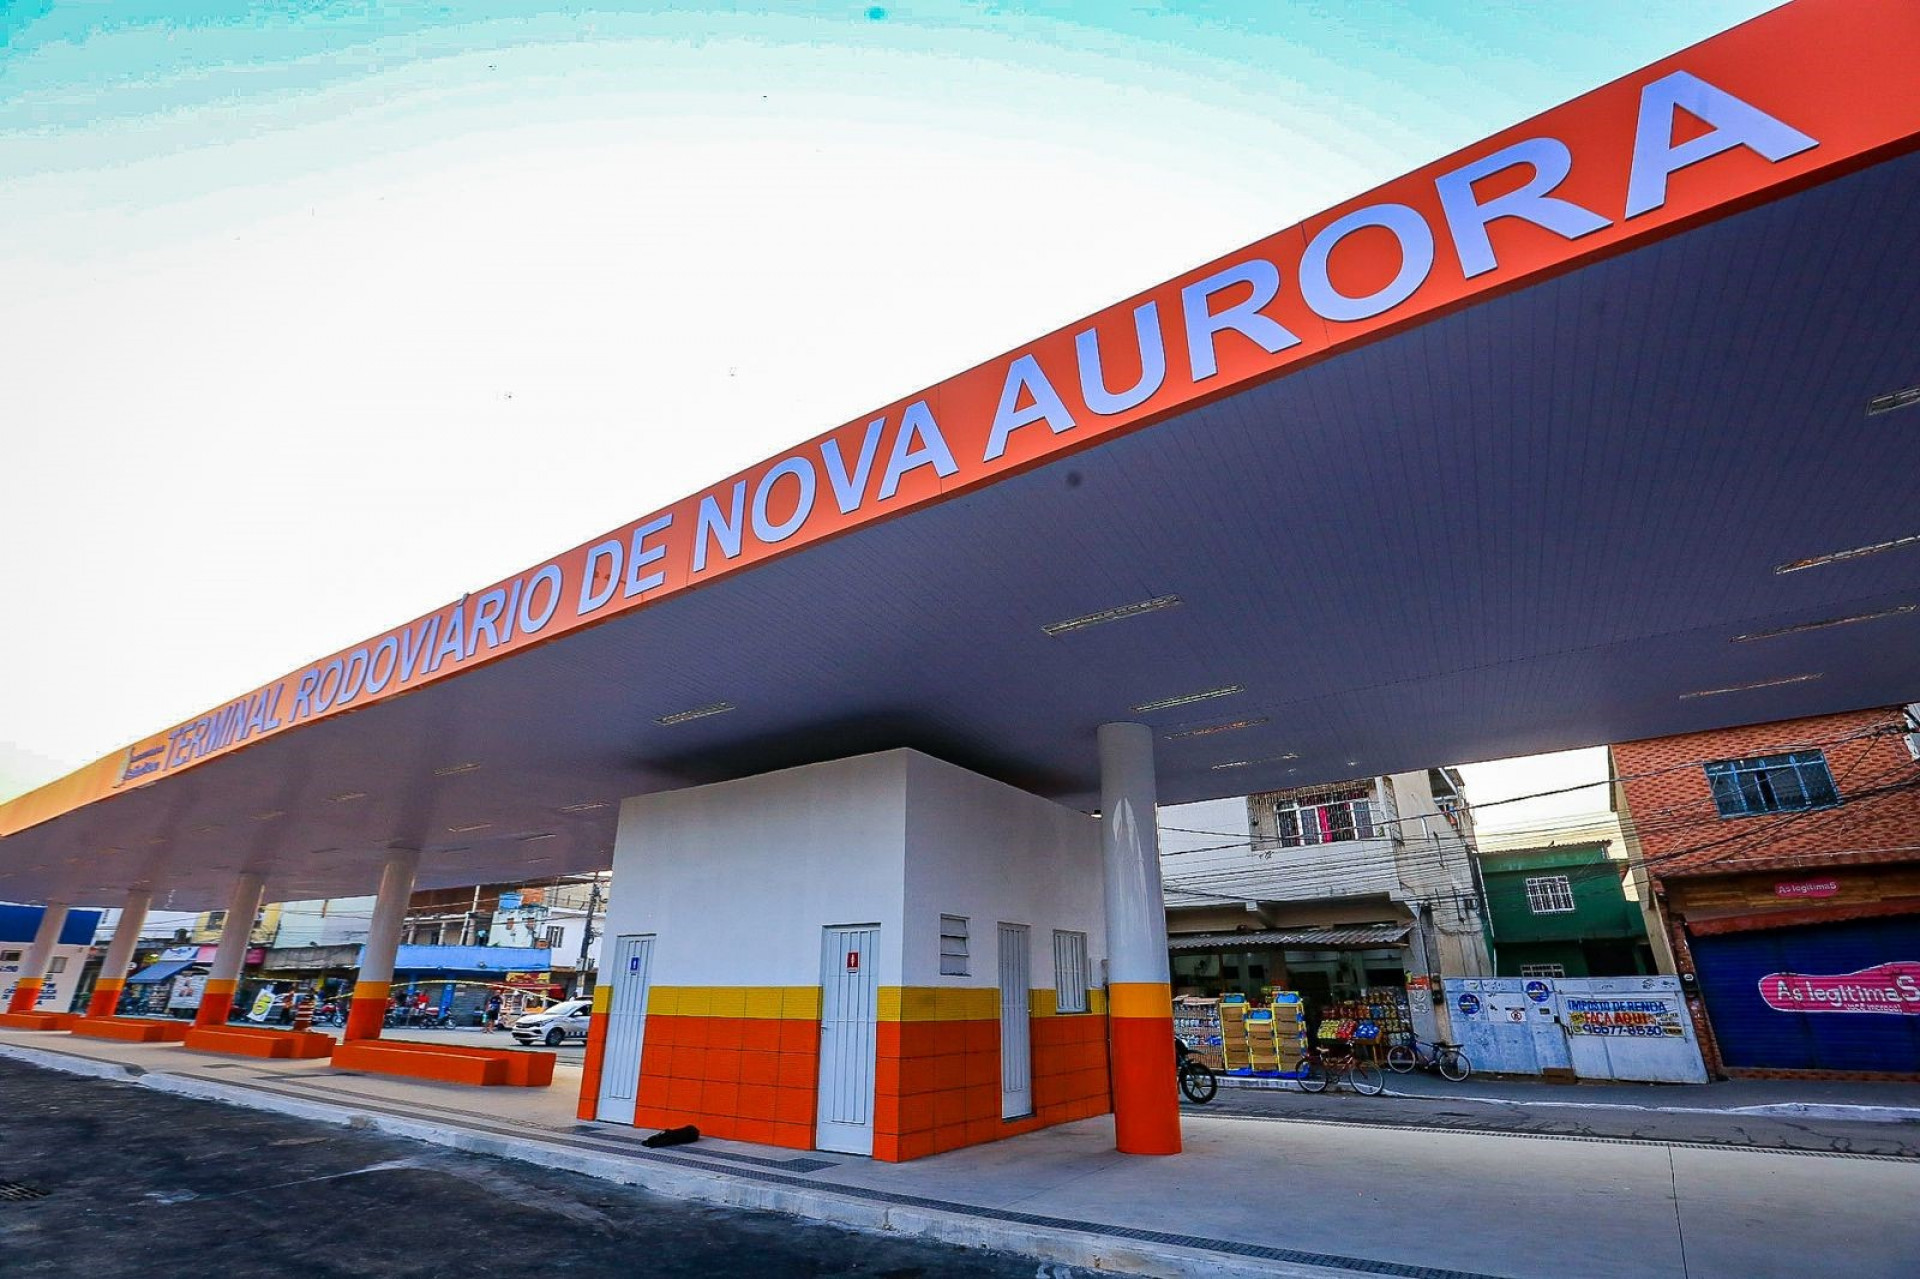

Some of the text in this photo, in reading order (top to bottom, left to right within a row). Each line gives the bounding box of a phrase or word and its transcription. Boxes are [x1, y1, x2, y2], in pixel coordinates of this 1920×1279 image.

[162, 69, 1819, 771] TERMINAL RODOVIÁRIO DE NOVA AURORA
[1777, 980, 1805, 1001] As
[1567, 1000, 1666, 1013] IMPOSTO DE RENDA
